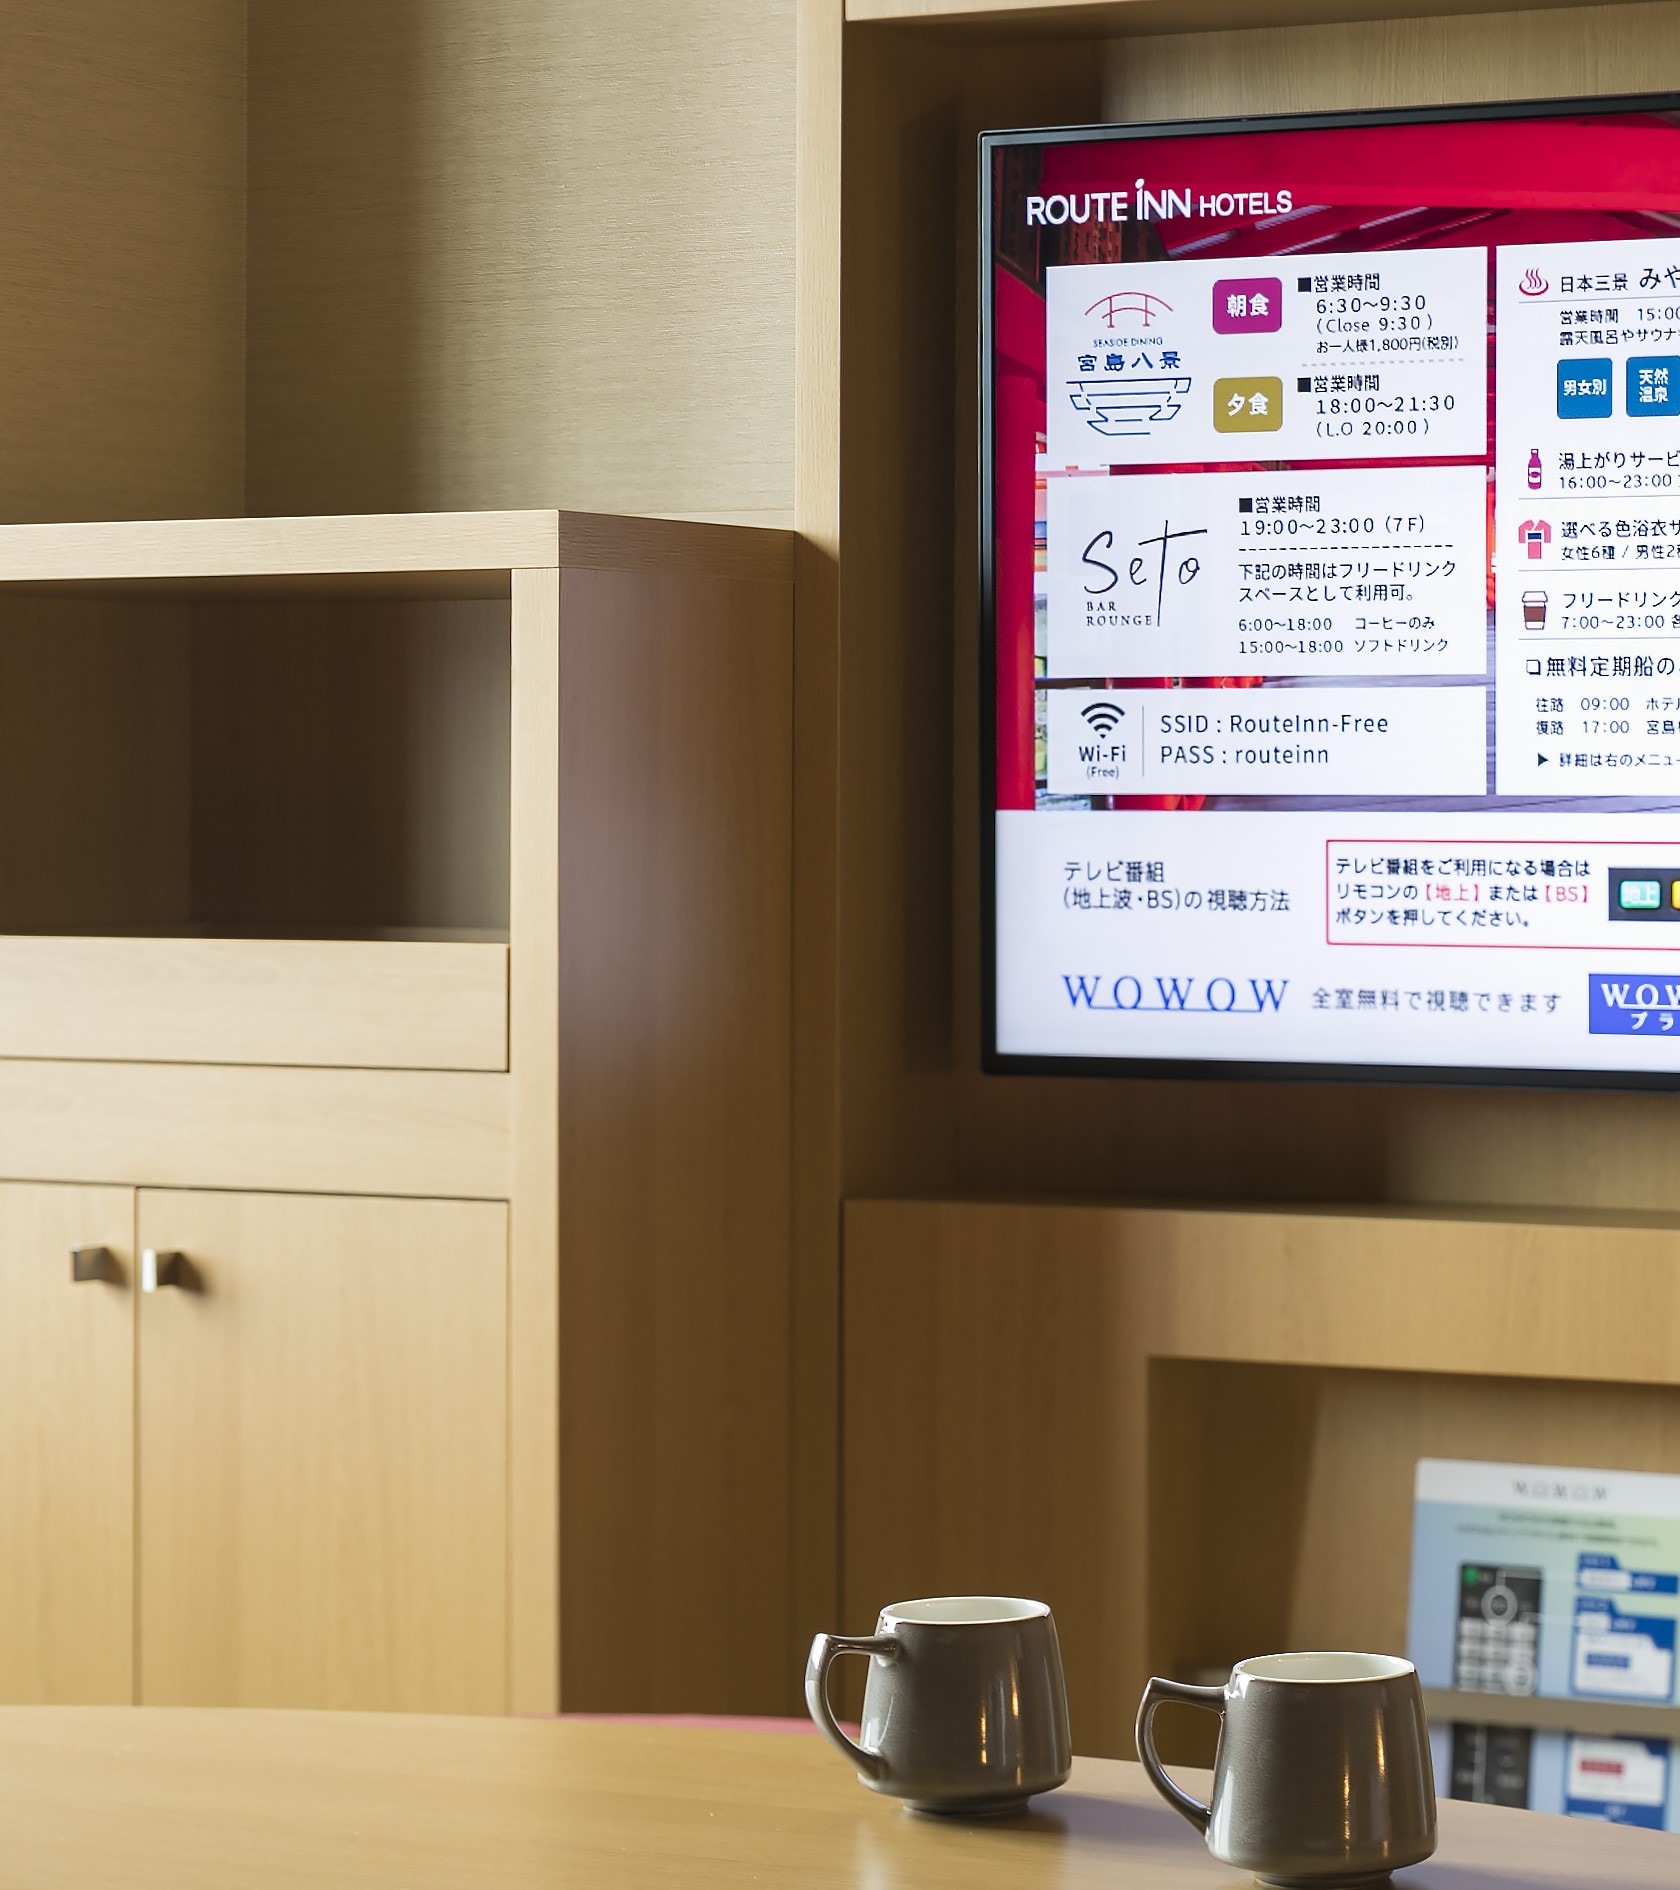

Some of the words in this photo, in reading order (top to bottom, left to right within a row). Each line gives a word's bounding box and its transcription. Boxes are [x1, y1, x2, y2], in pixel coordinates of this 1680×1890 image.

[1027, 192, 1127, 226] ROUTE
[1199, 190, 1292, 217] HOTELS
[1313, 273, 1380, 293] 営業時間
[1560, 273, 1628, 293] 日本三景
[1227, 294, 1269, 318] 朝食
[1559, 308, 1618, 325] 営業時間
[1093, 338, 1128, 348] SEASDE
[1130, 337, 1162, 346] DINNG
[1078, 352, 1180, 371] 宮島八景
[1313, 374, 1380, 393] 営業時間
[1639, 368, 1669, 384] 天然
[1564, 379, 1606, 396] 男女別
[1639, 387, 1669, 403] 温泉
[1227, 393, 1269, 417] 夕食
[1256, 496, 1320, 514] 営業時間
[1561, 545, 1615, 560] 女性6種
[1238, 560, 1456, 580] 下記の時間はフリードリンク
[1086, 601, 1116, 611] BAR
[1086, 615, 1152, 626] ROUNGE
[1355, 615, 1435, 630] コーヒーのみ
[1355, 638, 1449, 652] ソフトドリンク
[1536, 697, 1564, 712] 往路
[1580, 697, 1630, 711] 09:00
[1160, 714, 1208, 733] SSID
[1230, 714, 1388, 733] RouteInn-Free
[1583, 720, 1630, 734] 17:00
[1079, 745, 1126, 762] Wi-Fi
[1160, 746, 1214, 764] PASS
[1235, 745, 1329, 764] routeinn
[1087, 765, 1119, 779] (Free)
[1064, 861, 1164, 884] テレビ番組
[1336, 858, 1590, 877] テレビ番組をご利用になる場合は
[1063, 975, 1290, 1012] WOWOW
[1312, 986, 1562, 1014] 全室無料で視聴できます
